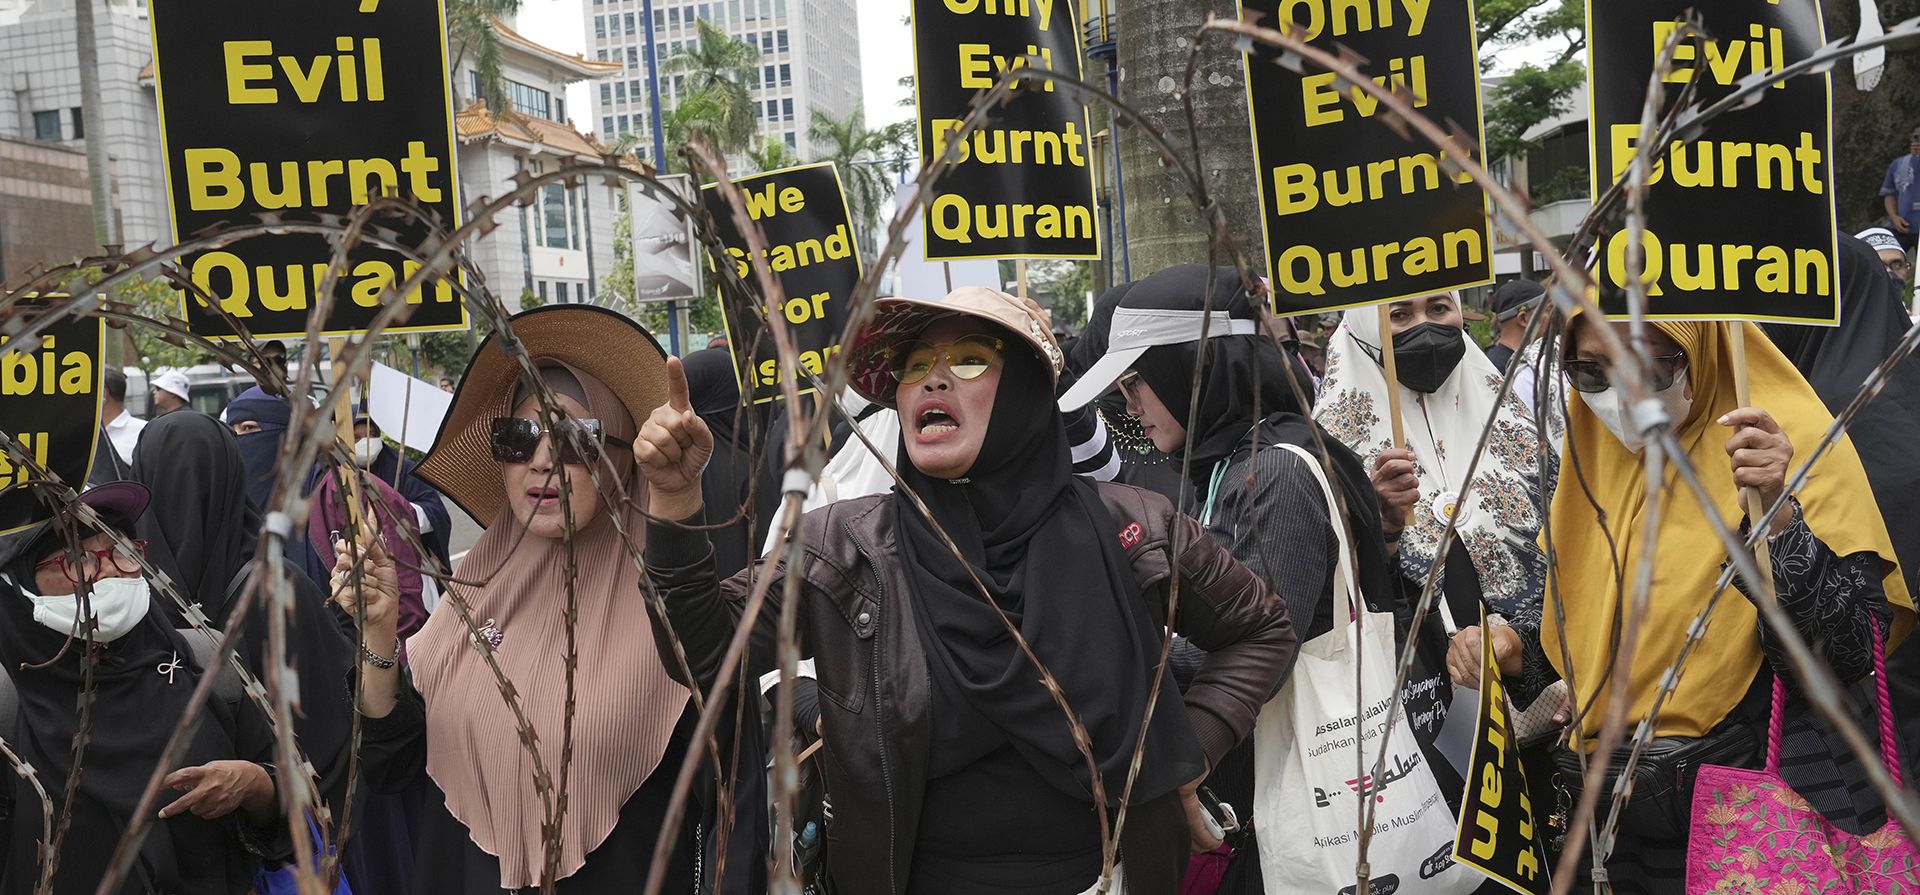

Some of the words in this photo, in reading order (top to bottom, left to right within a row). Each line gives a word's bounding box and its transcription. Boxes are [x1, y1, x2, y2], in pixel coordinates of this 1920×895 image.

[223, 36, 385, 105] Evil
[958, 44, 1054, 93] Evl
[1652, 21, 1786, 90] Evil
[184, 140, 442, 211] Burnt
[931, 119, 1085, 167] Burnt
[1610, 123, 1824, 196] Burnt
[741, 182, 806, 222] We
[931, 193, 1093, 244] Quran
[191, 251, 454, 318] Quran
[1277, 228, 1483, 297] Quran
[1606, 228, 1830, 301] Quran
[762, 291, 831, 325] or
[747, 344, 842, 390] Isa
